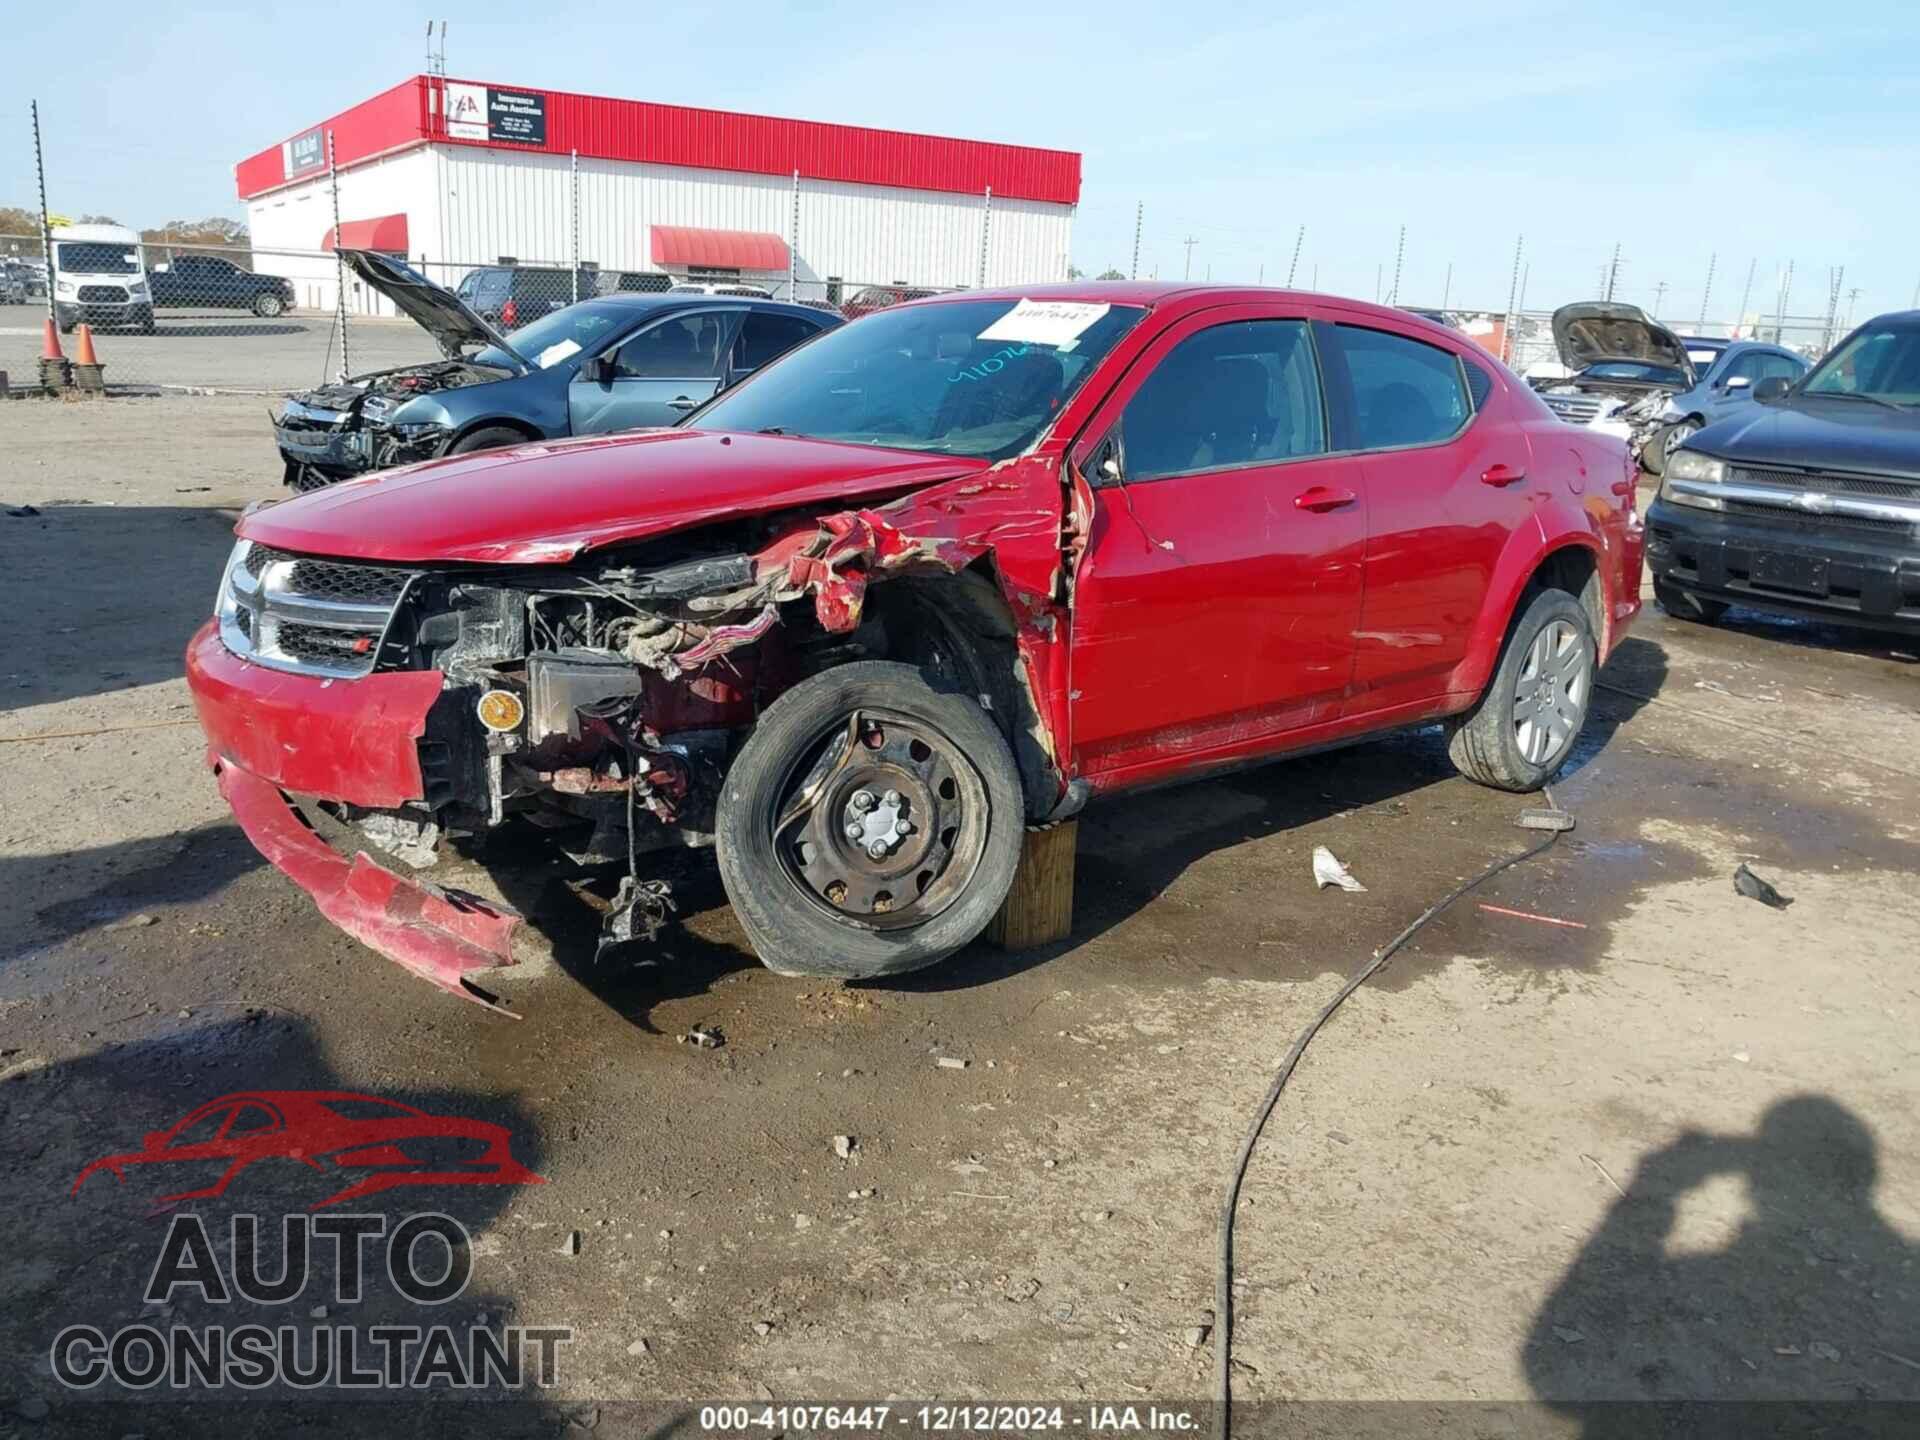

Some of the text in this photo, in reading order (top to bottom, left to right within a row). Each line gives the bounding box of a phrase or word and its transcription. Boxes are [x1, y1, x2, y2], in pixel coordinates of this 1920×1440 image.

[498, 93, 535, 105] Insurance
[491, 101, 542, 115] Auto Auctions
